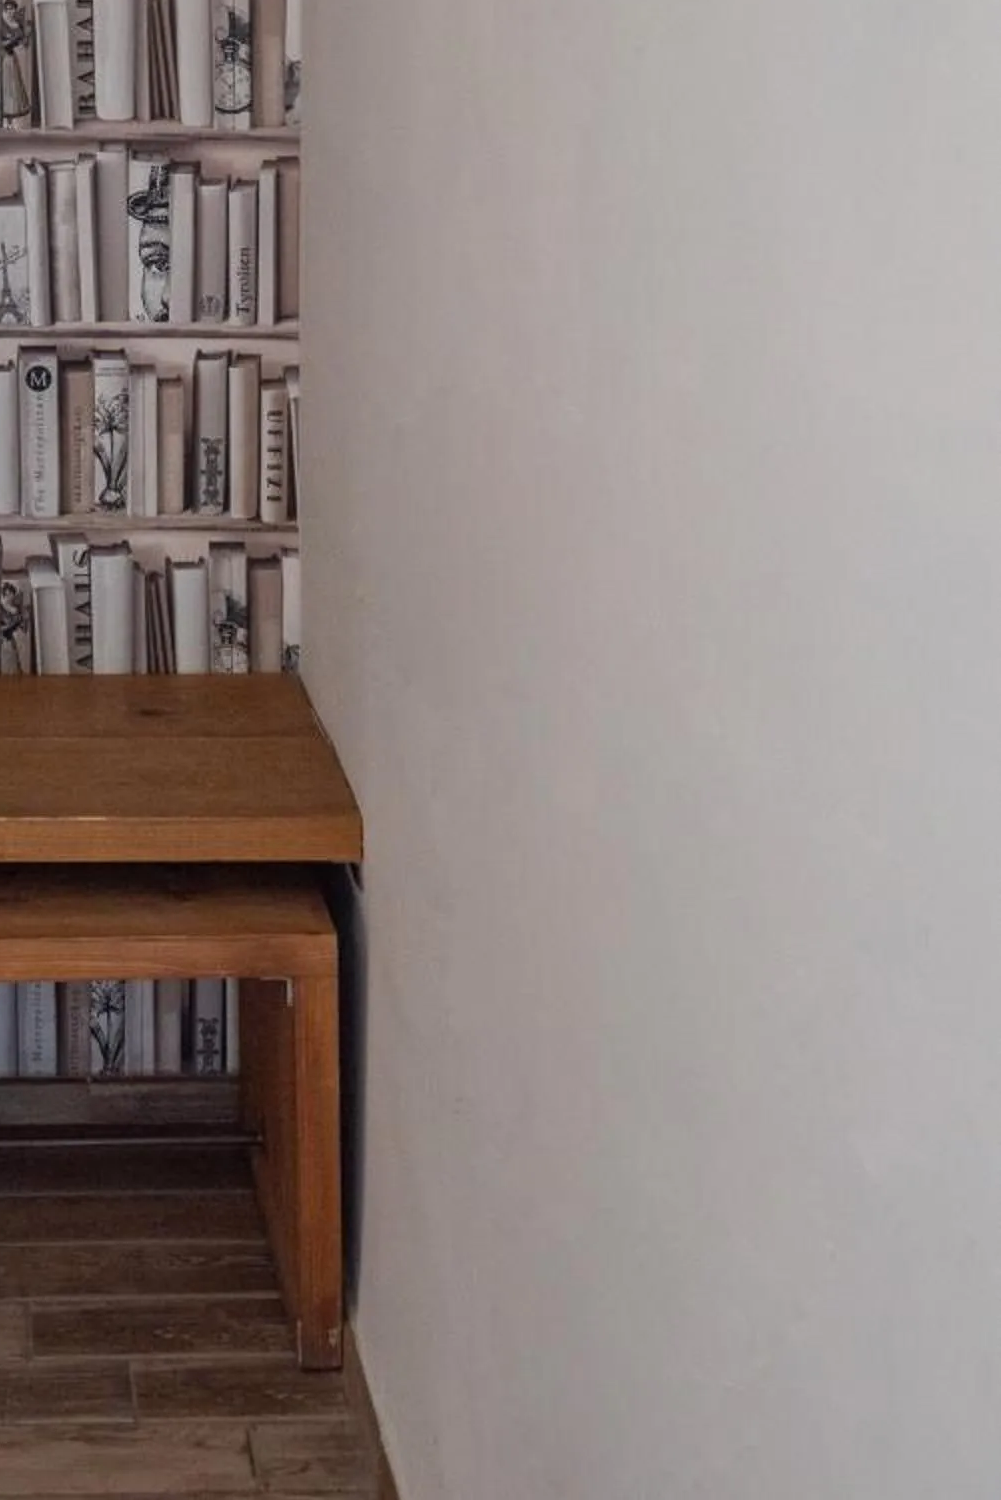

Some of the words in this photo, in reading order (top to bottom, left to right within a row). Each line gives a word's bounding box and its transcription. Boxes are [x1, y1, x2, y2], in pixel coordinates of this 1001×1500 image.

[235, 246, 253, 317] Tyrolien
[27, 367, 51, 391] M
[266, 409, 284, 503] UFFIZI
